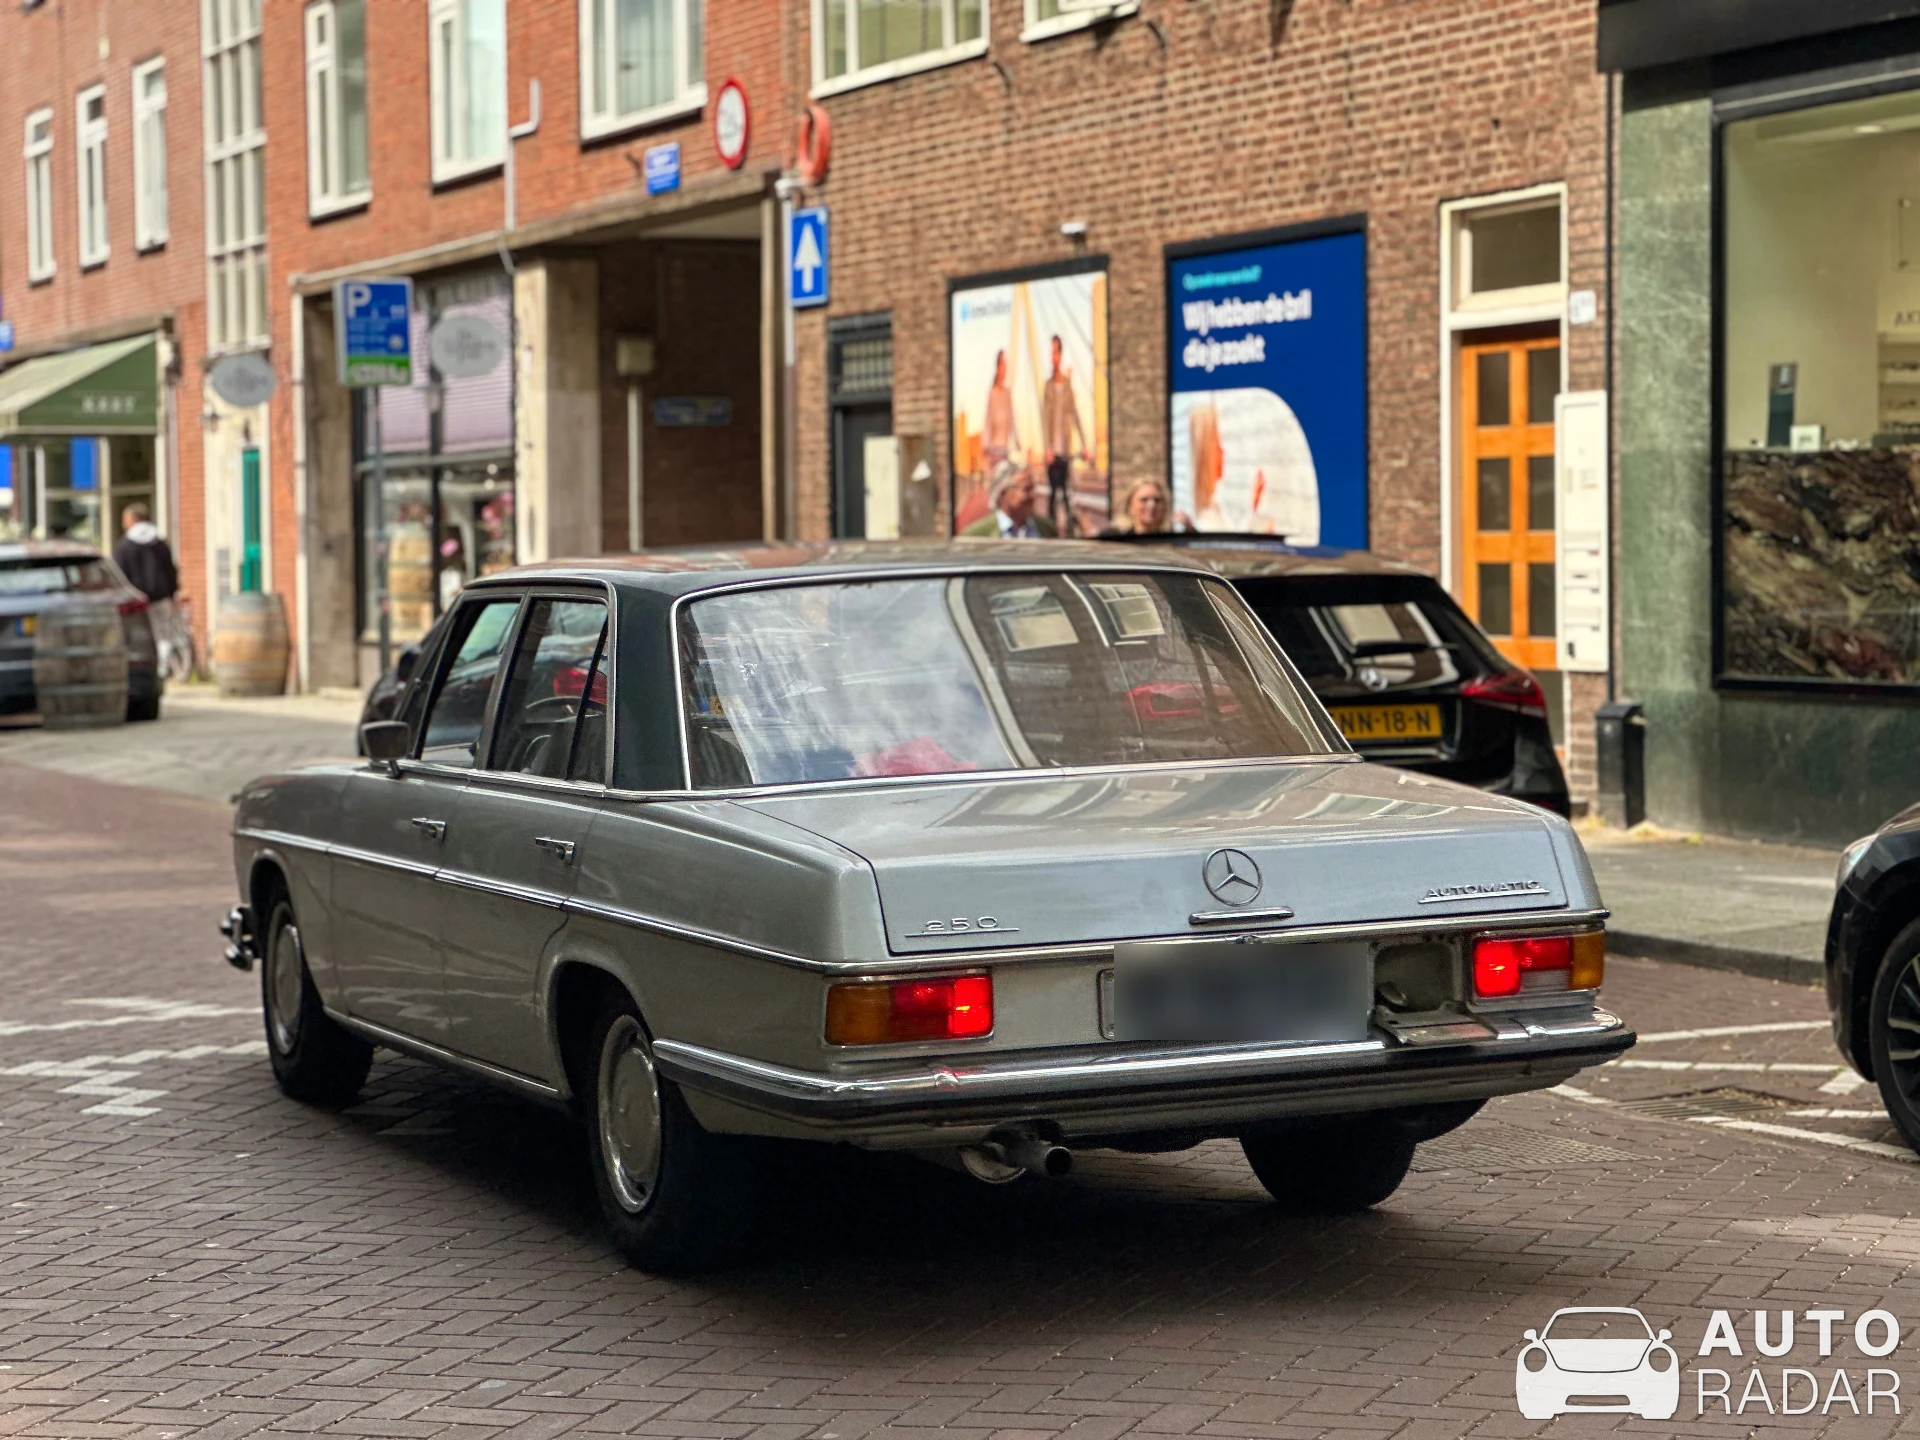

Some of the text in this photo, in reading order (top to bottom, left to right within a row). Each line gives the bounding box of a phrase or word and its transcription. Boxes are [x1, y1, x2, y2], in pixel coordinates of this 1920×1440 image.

[347, 285, 372, 319] P
[1329, 709, 1431, 735] NN-18-N
[1426, 880, 1540, 898] AUTOMATIC
[925, 916, 998, 931] 250
